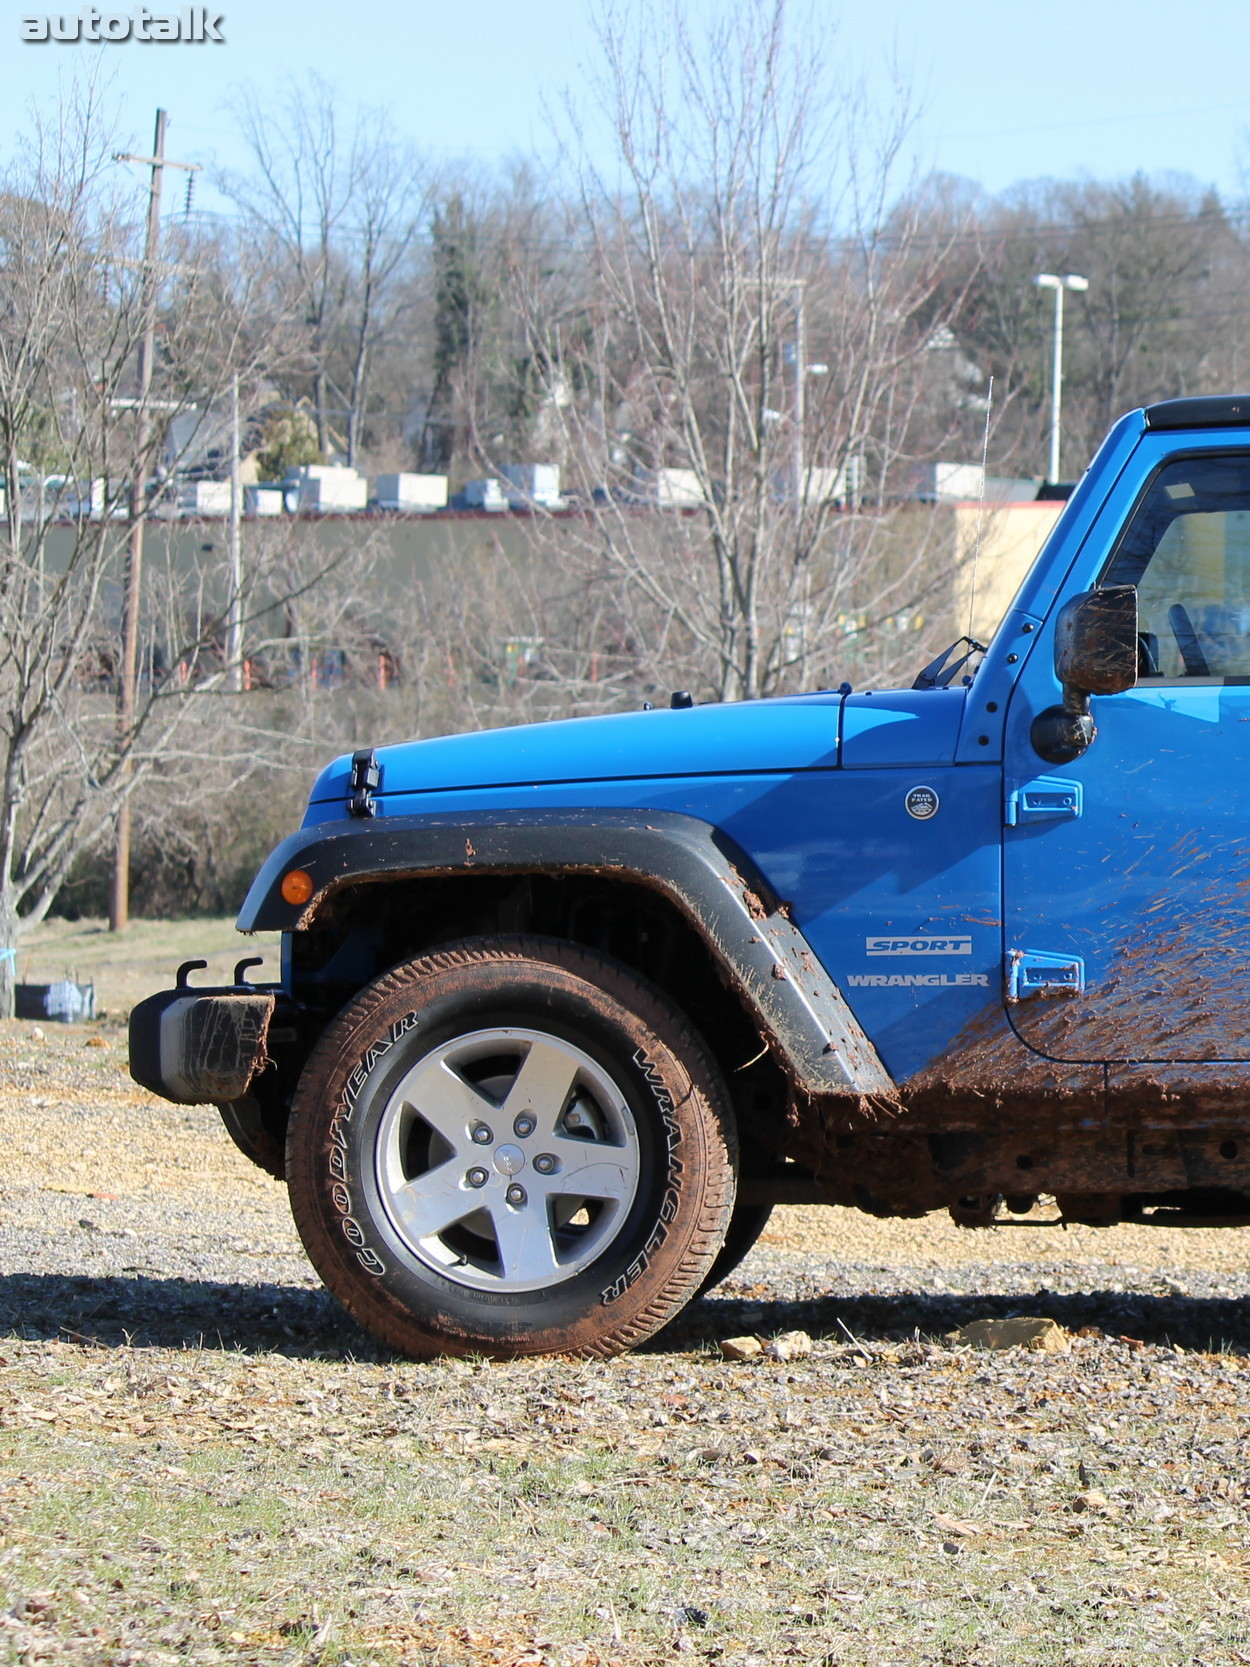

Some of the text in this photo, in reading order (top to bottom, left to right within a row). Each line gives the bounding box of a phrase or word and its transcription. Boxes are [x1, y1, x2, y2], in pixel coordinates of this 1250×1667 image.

[846, 974, 990, 987] WRANGLER
[866, 940, 971, 952] SPORT
[329, 1010, 419, 1276] GOODYEAR
[602, 1045, 685, 1306] WRANGLER
